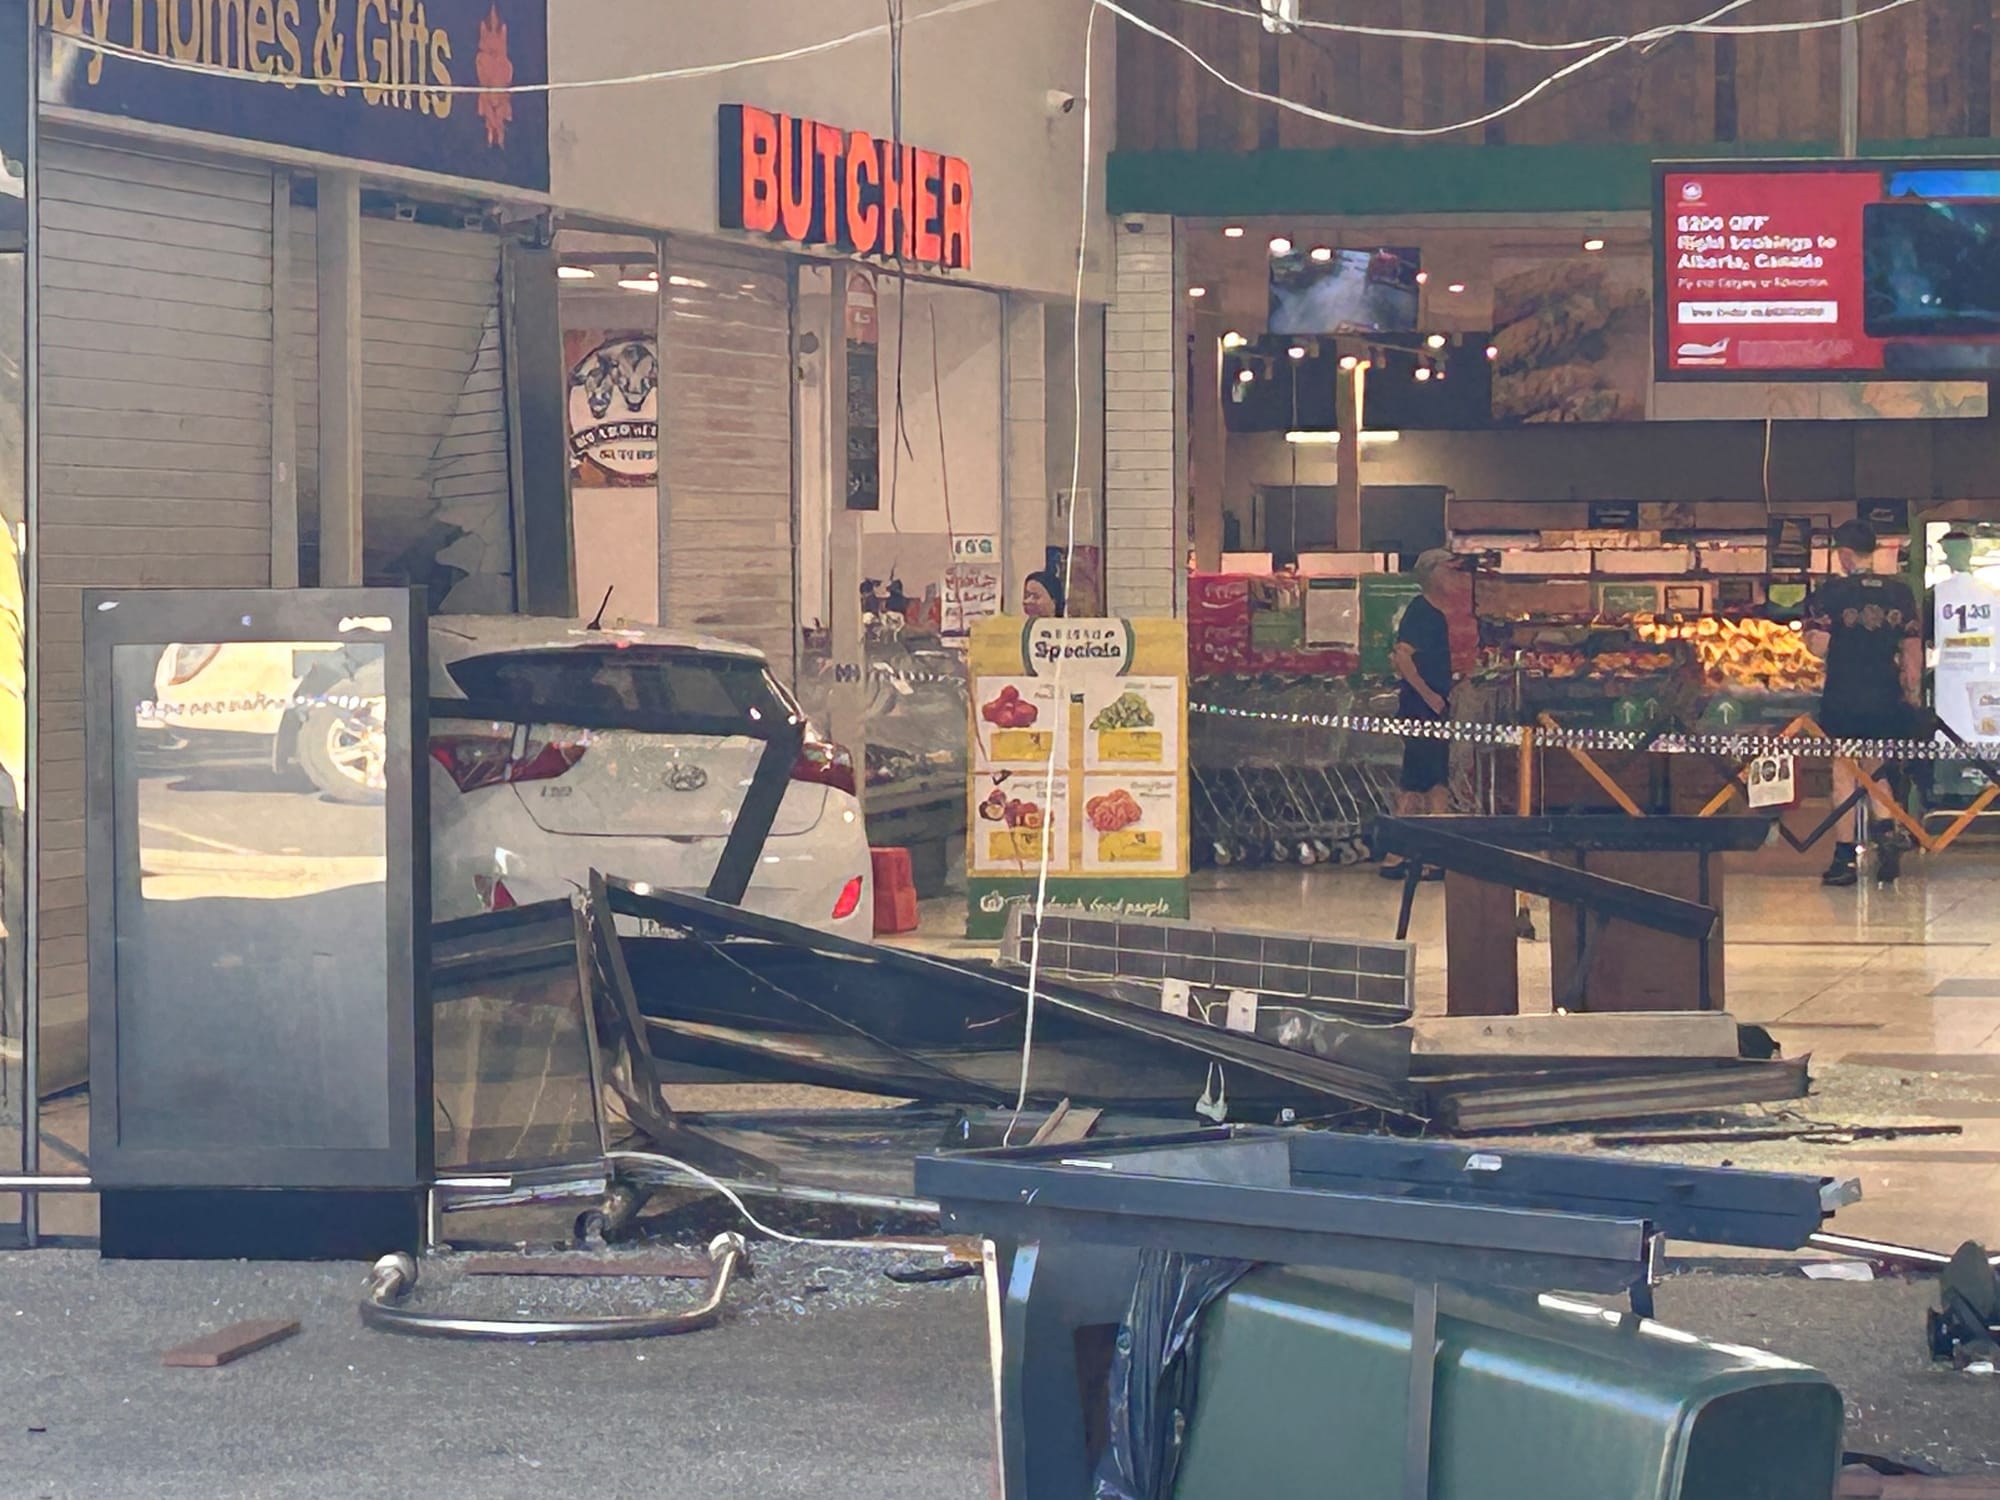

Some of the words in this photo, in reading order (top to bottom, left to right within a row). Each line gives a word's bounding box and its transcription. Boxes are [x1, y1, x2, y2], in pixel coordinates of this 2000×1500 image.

[39, 0, 111, 85] py
[313, 0, 346, 98] &
[356, 0, 452, 119] Gifts
[738, 104, 972, 272] BUTCHER
[1728, 215, 1770, 232] OFF
[1817, 235, 1837, 249] to
[1035, 641, 1120, 662] Specials
